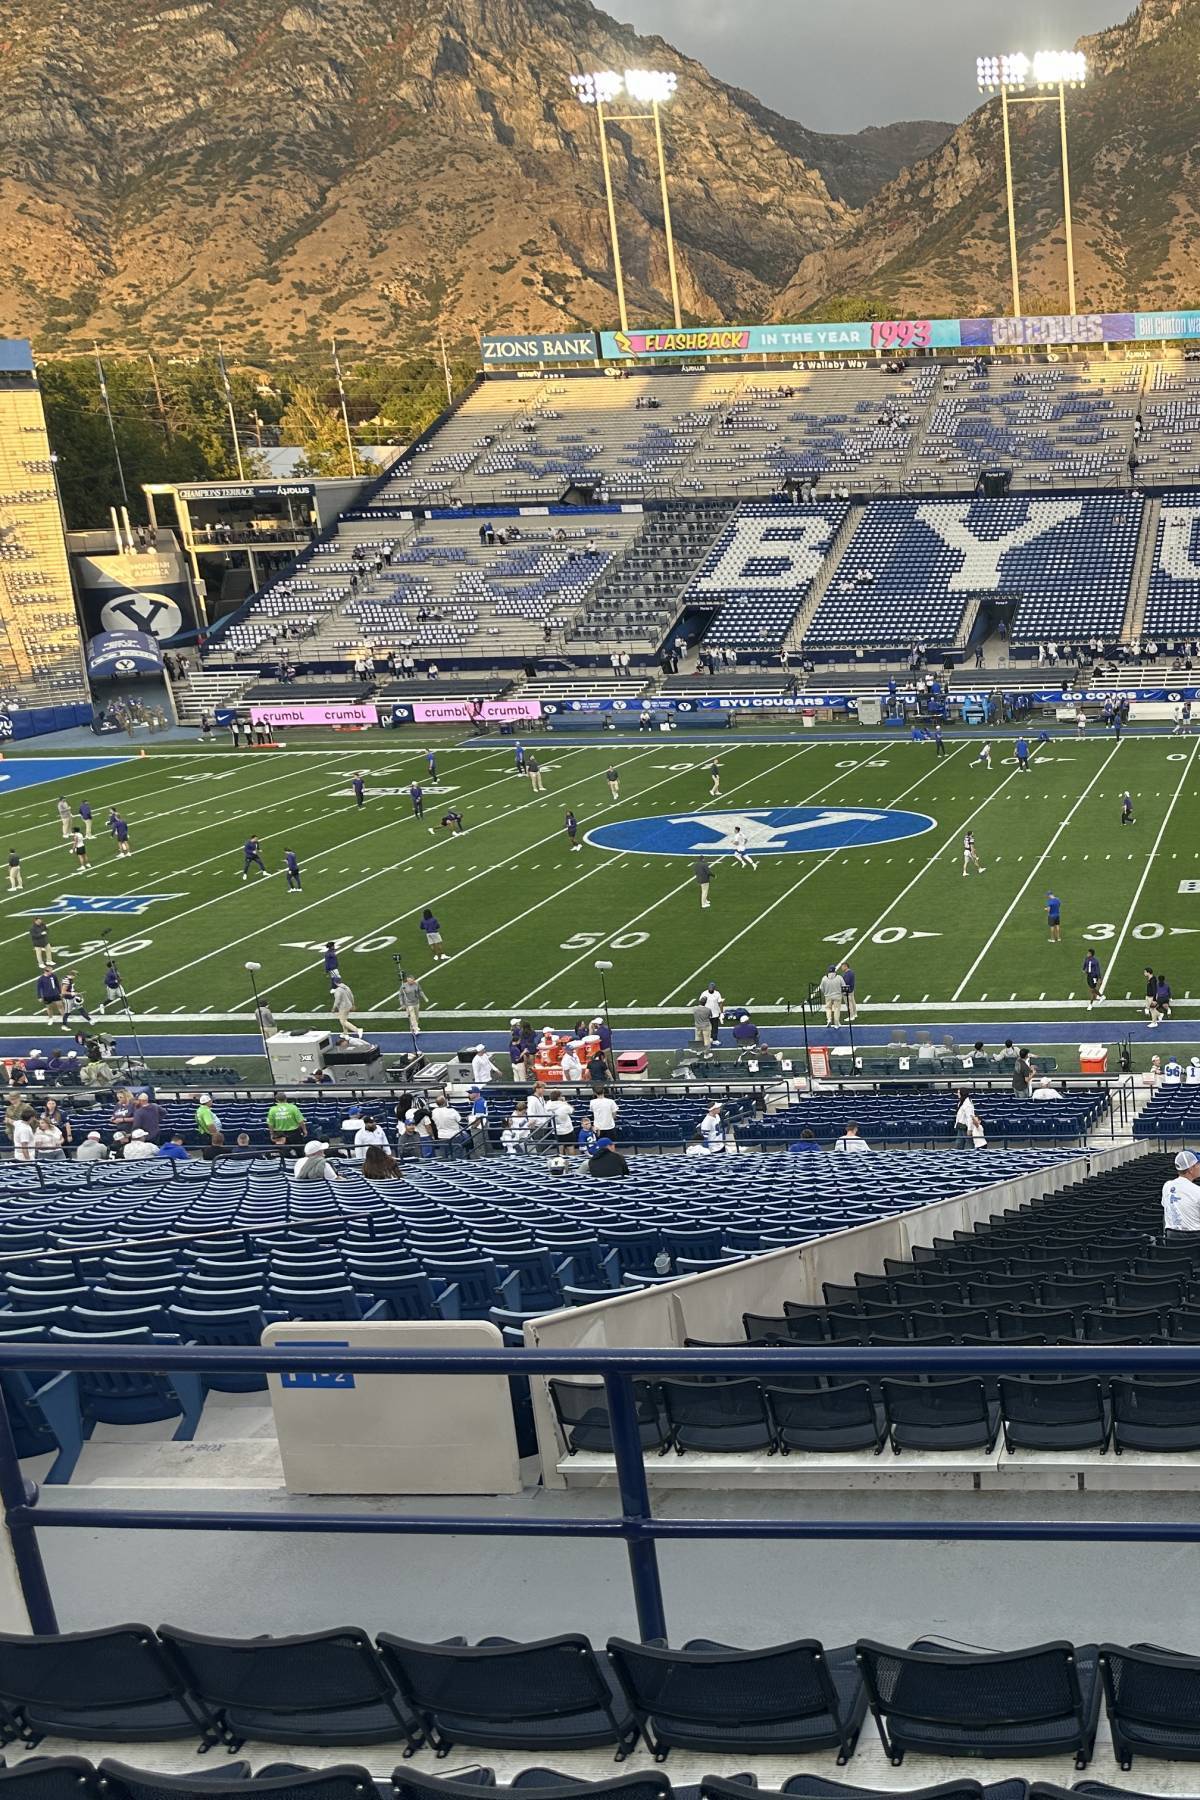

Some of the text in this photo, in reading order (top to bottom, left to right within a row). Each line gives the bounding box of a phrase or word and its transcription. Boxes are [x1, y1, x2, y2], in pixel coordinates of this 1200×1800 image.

[992, 315, 1104, 345] GO COUGS
[1139, 318, 1154, 335] Bill
[1155, 316, 1186, 334] Clinton
[644, 331, 743, 351] FLASHBACK
[761, 330, 861, 345] IN THE YEAR
[870, 320, 932, 348] 1993
[483, 339, 594, 358] ZIONS BANK
[792, 359, 868, 371] 42 Wallaby Way
[180, 487, 254, 498] CHAMPIONS TERRACE
[276, 486, 310, 496] smarty
[719, 696, 825, 708] BYU COUGARS
[1061, 692, 1084, 701] GO
[324, 707, 367, 720] crumbl
[425, 704, 467, 718] crumbl
[487, 702, 530, 716] crumbl
[821, 926, 908, 945] 40
[1082, 923, 1165, 940] 30
[560, 931, 651, 949] 50
[1165, 1065, 1180, 1077] 96
[1190, 1068, 1196, 1077] 1
